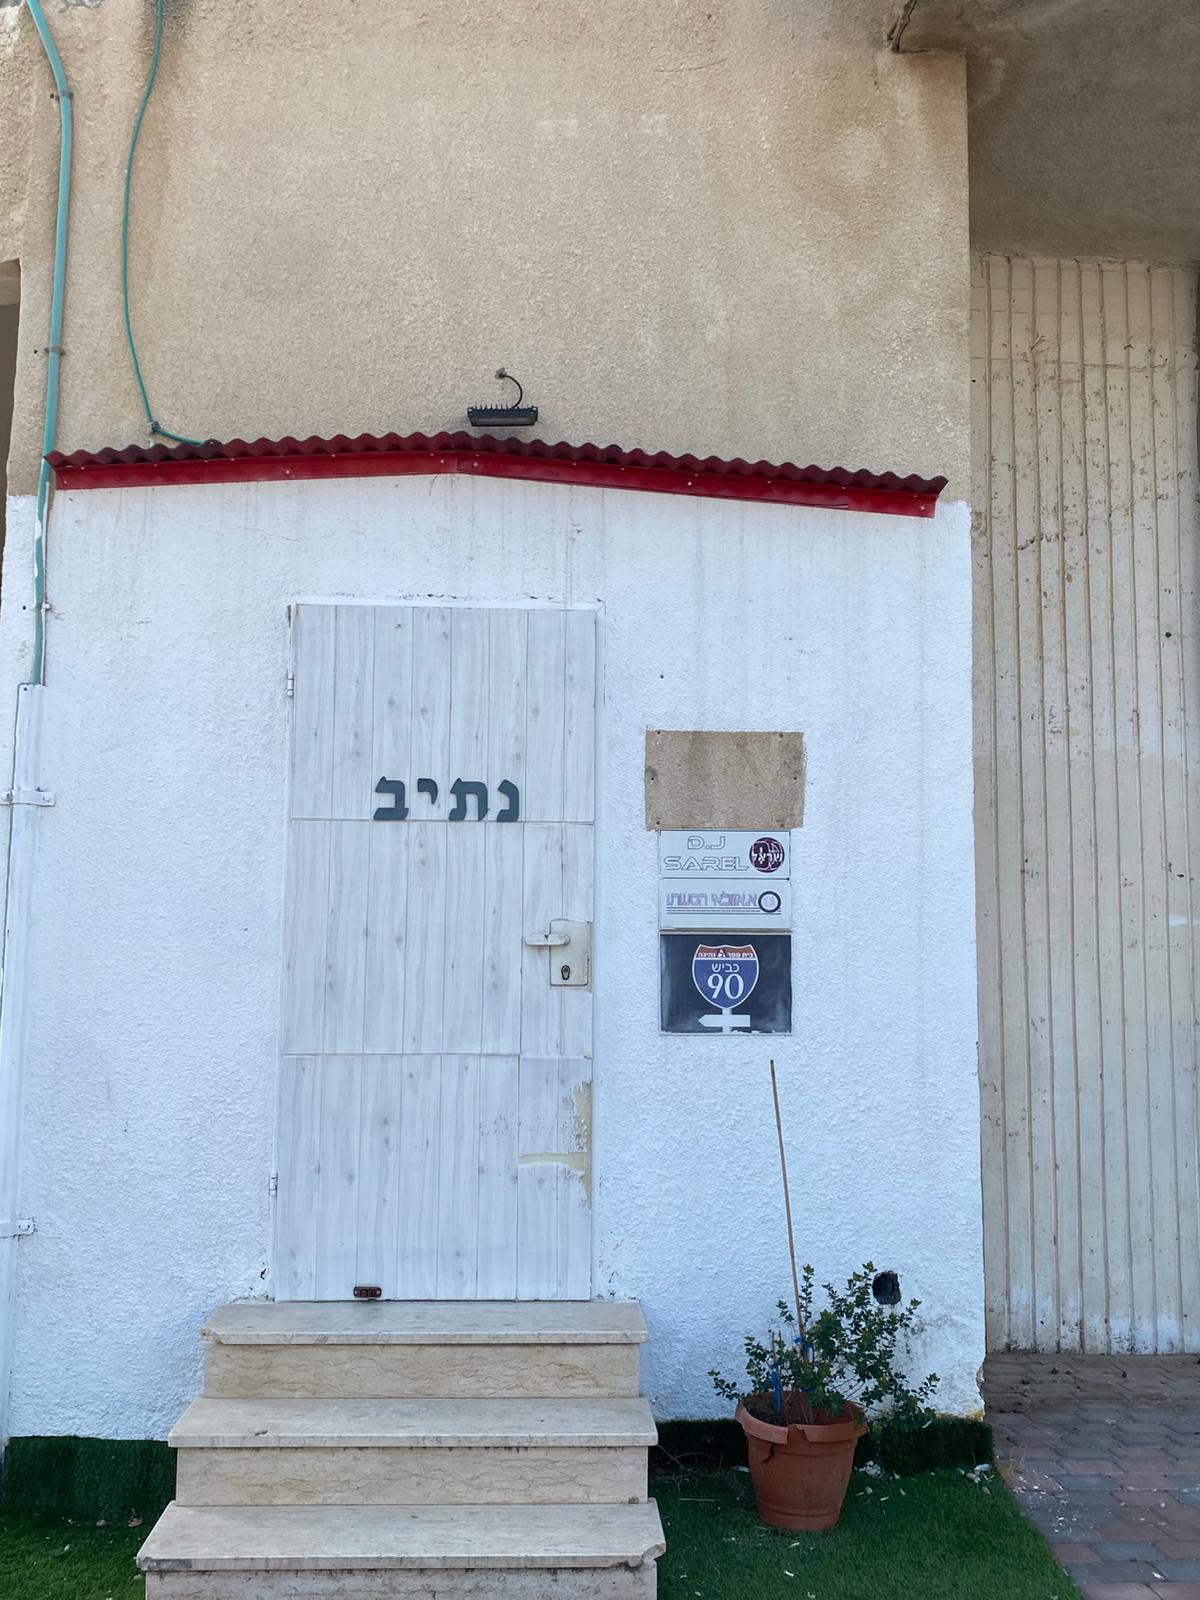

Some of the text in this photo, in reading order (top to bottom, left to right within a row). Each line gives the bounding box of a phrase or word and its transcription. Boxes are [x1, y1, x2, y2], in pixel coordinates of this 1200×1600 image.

[373, 776, 519, 822] נתיב
[687, 836, 725, 850] D.J
[664, 856, 749, 871] SAREL
[666, 893, 708, 906] הסעות
[711, 963, 740, 973] כביש
[707, 973, 744, 1000] 90
